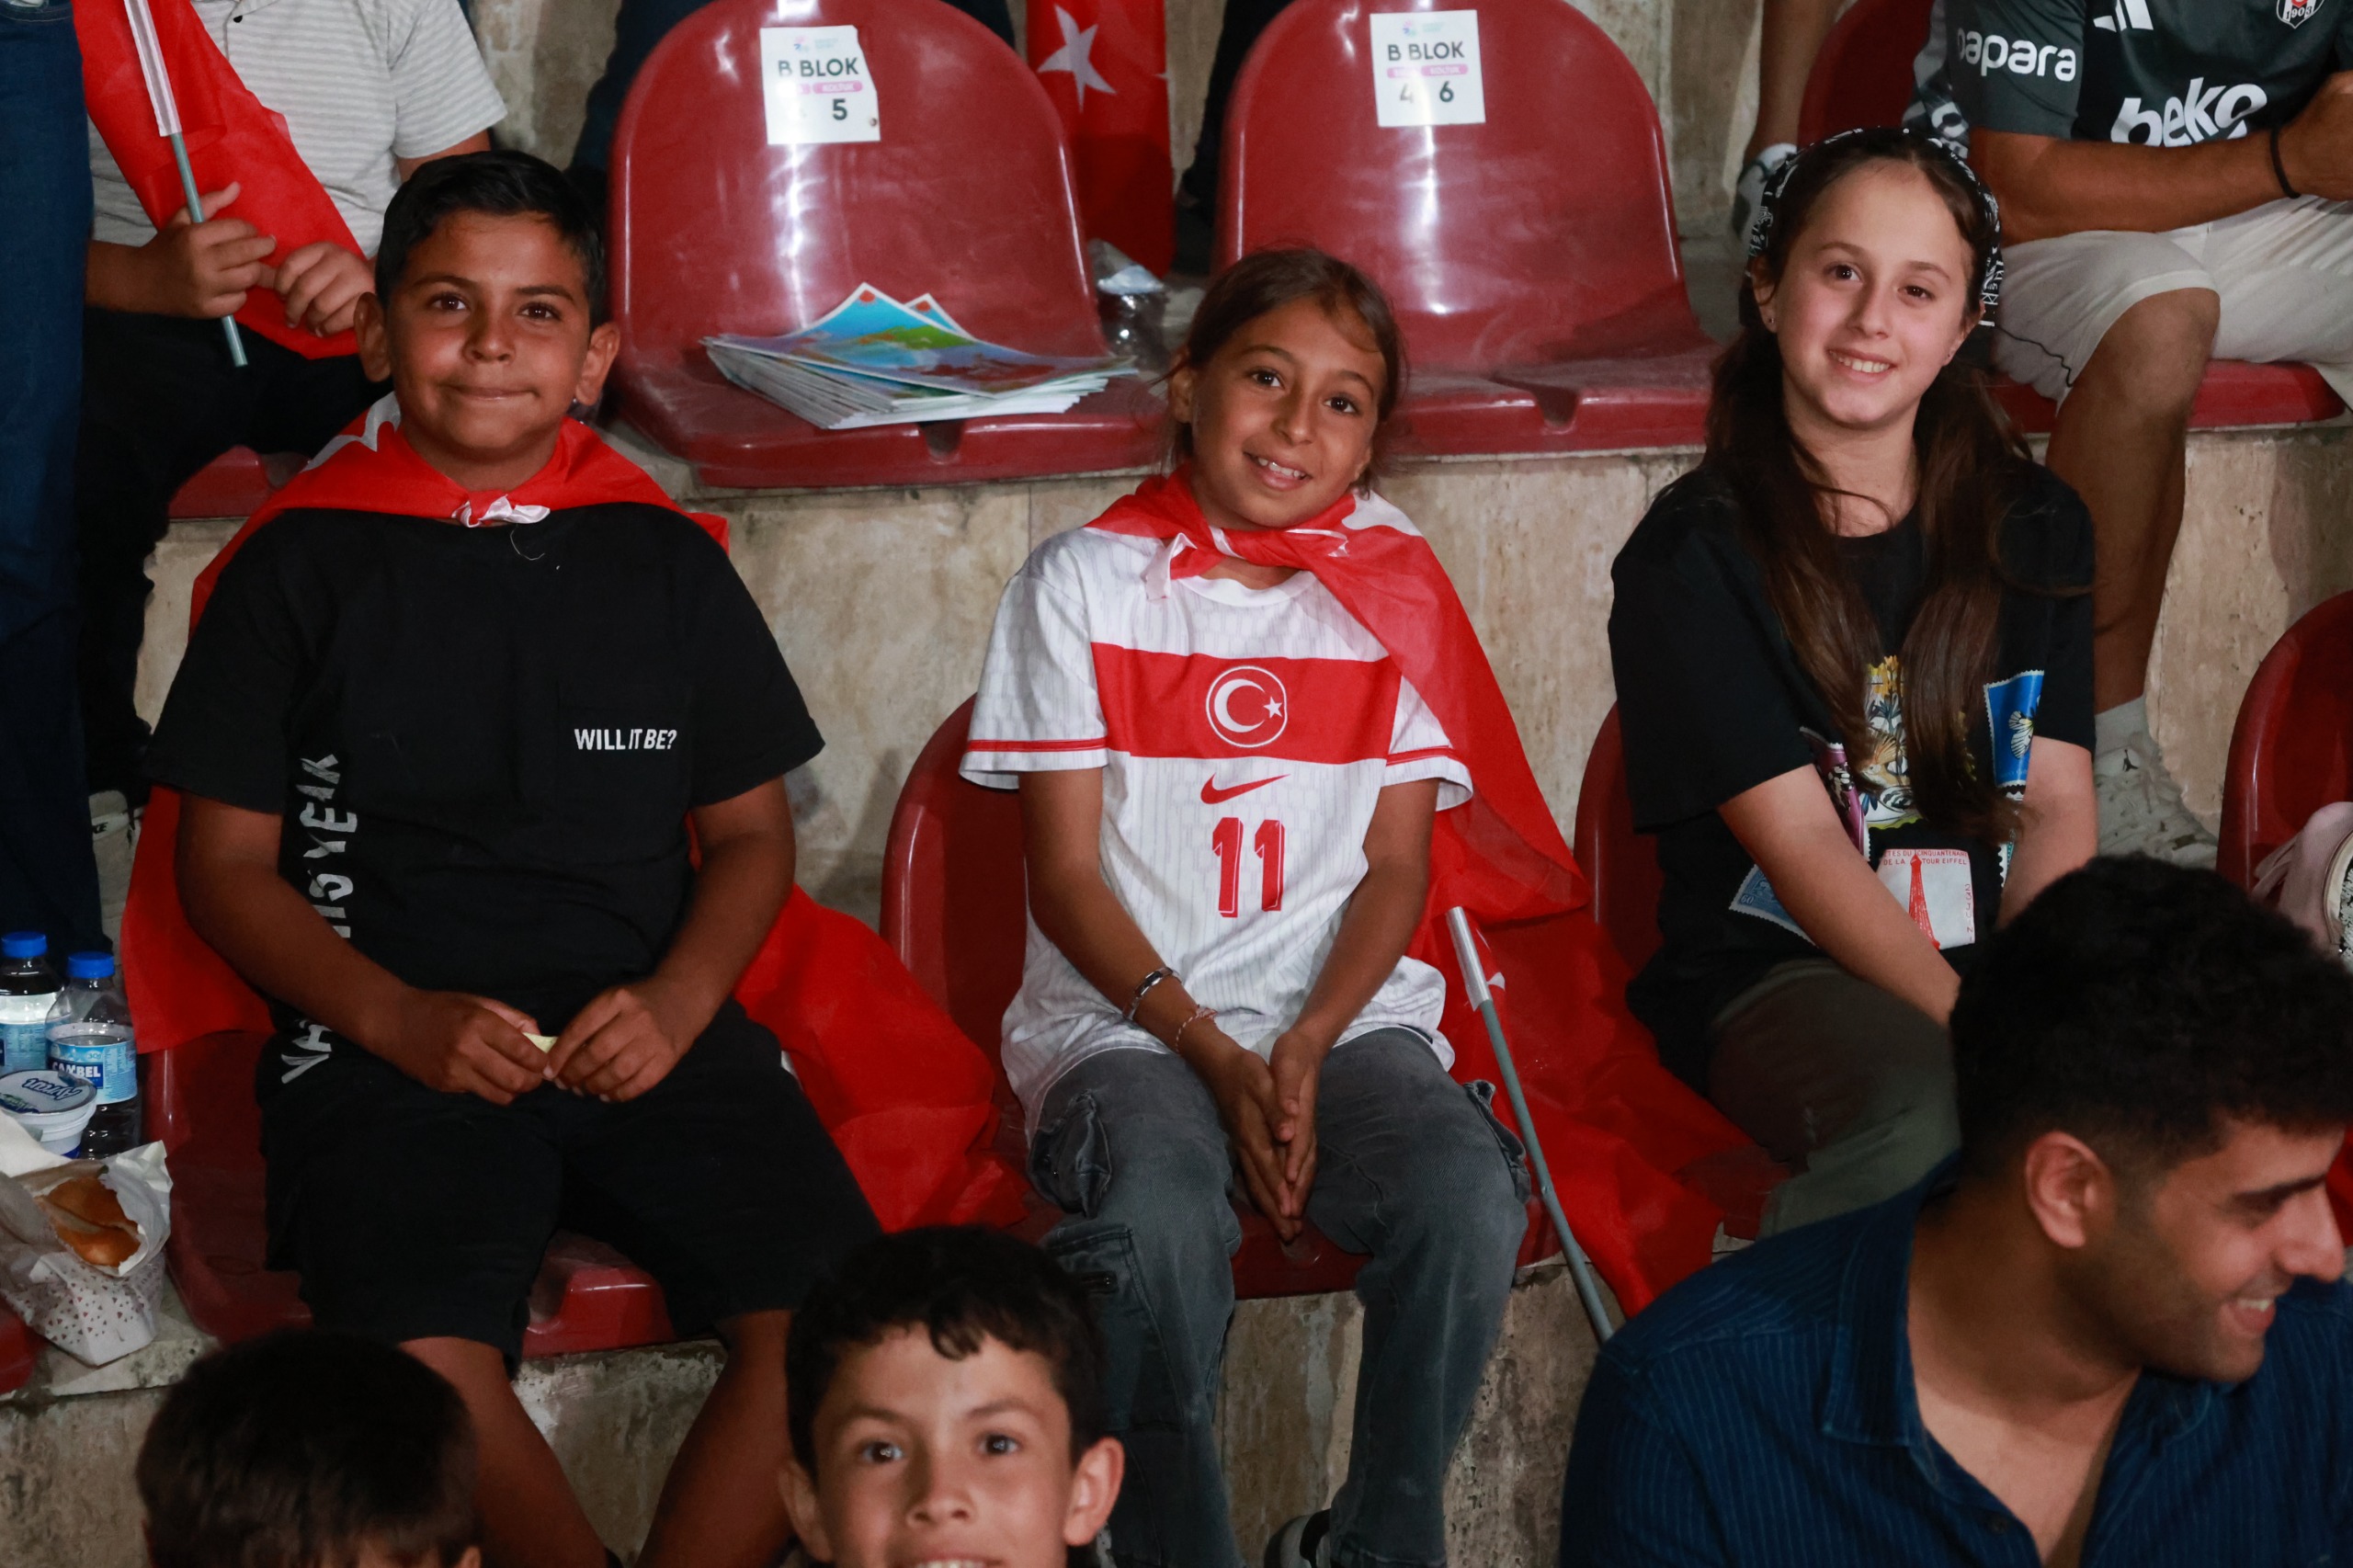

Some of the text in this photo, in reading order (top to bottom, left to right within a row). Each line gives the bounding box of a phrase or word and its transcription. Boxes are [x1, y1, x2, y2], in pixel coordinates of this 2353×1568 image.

[2285, 6, 2313, 20] 1903
[1387, 41, 1465, 62] B BLOK
[778, 57, 859, 77] B BLOK
[1438, 81, 1454, 103] 6
[832, 98, 847, 120] 5
[2110, 77, 2268, 147] beko
[574, 729, 677, 750] WILL IT BE?
[1211, 817, 1286, 917] 11
[1942, 858, 1967, 866] EIFFEL
